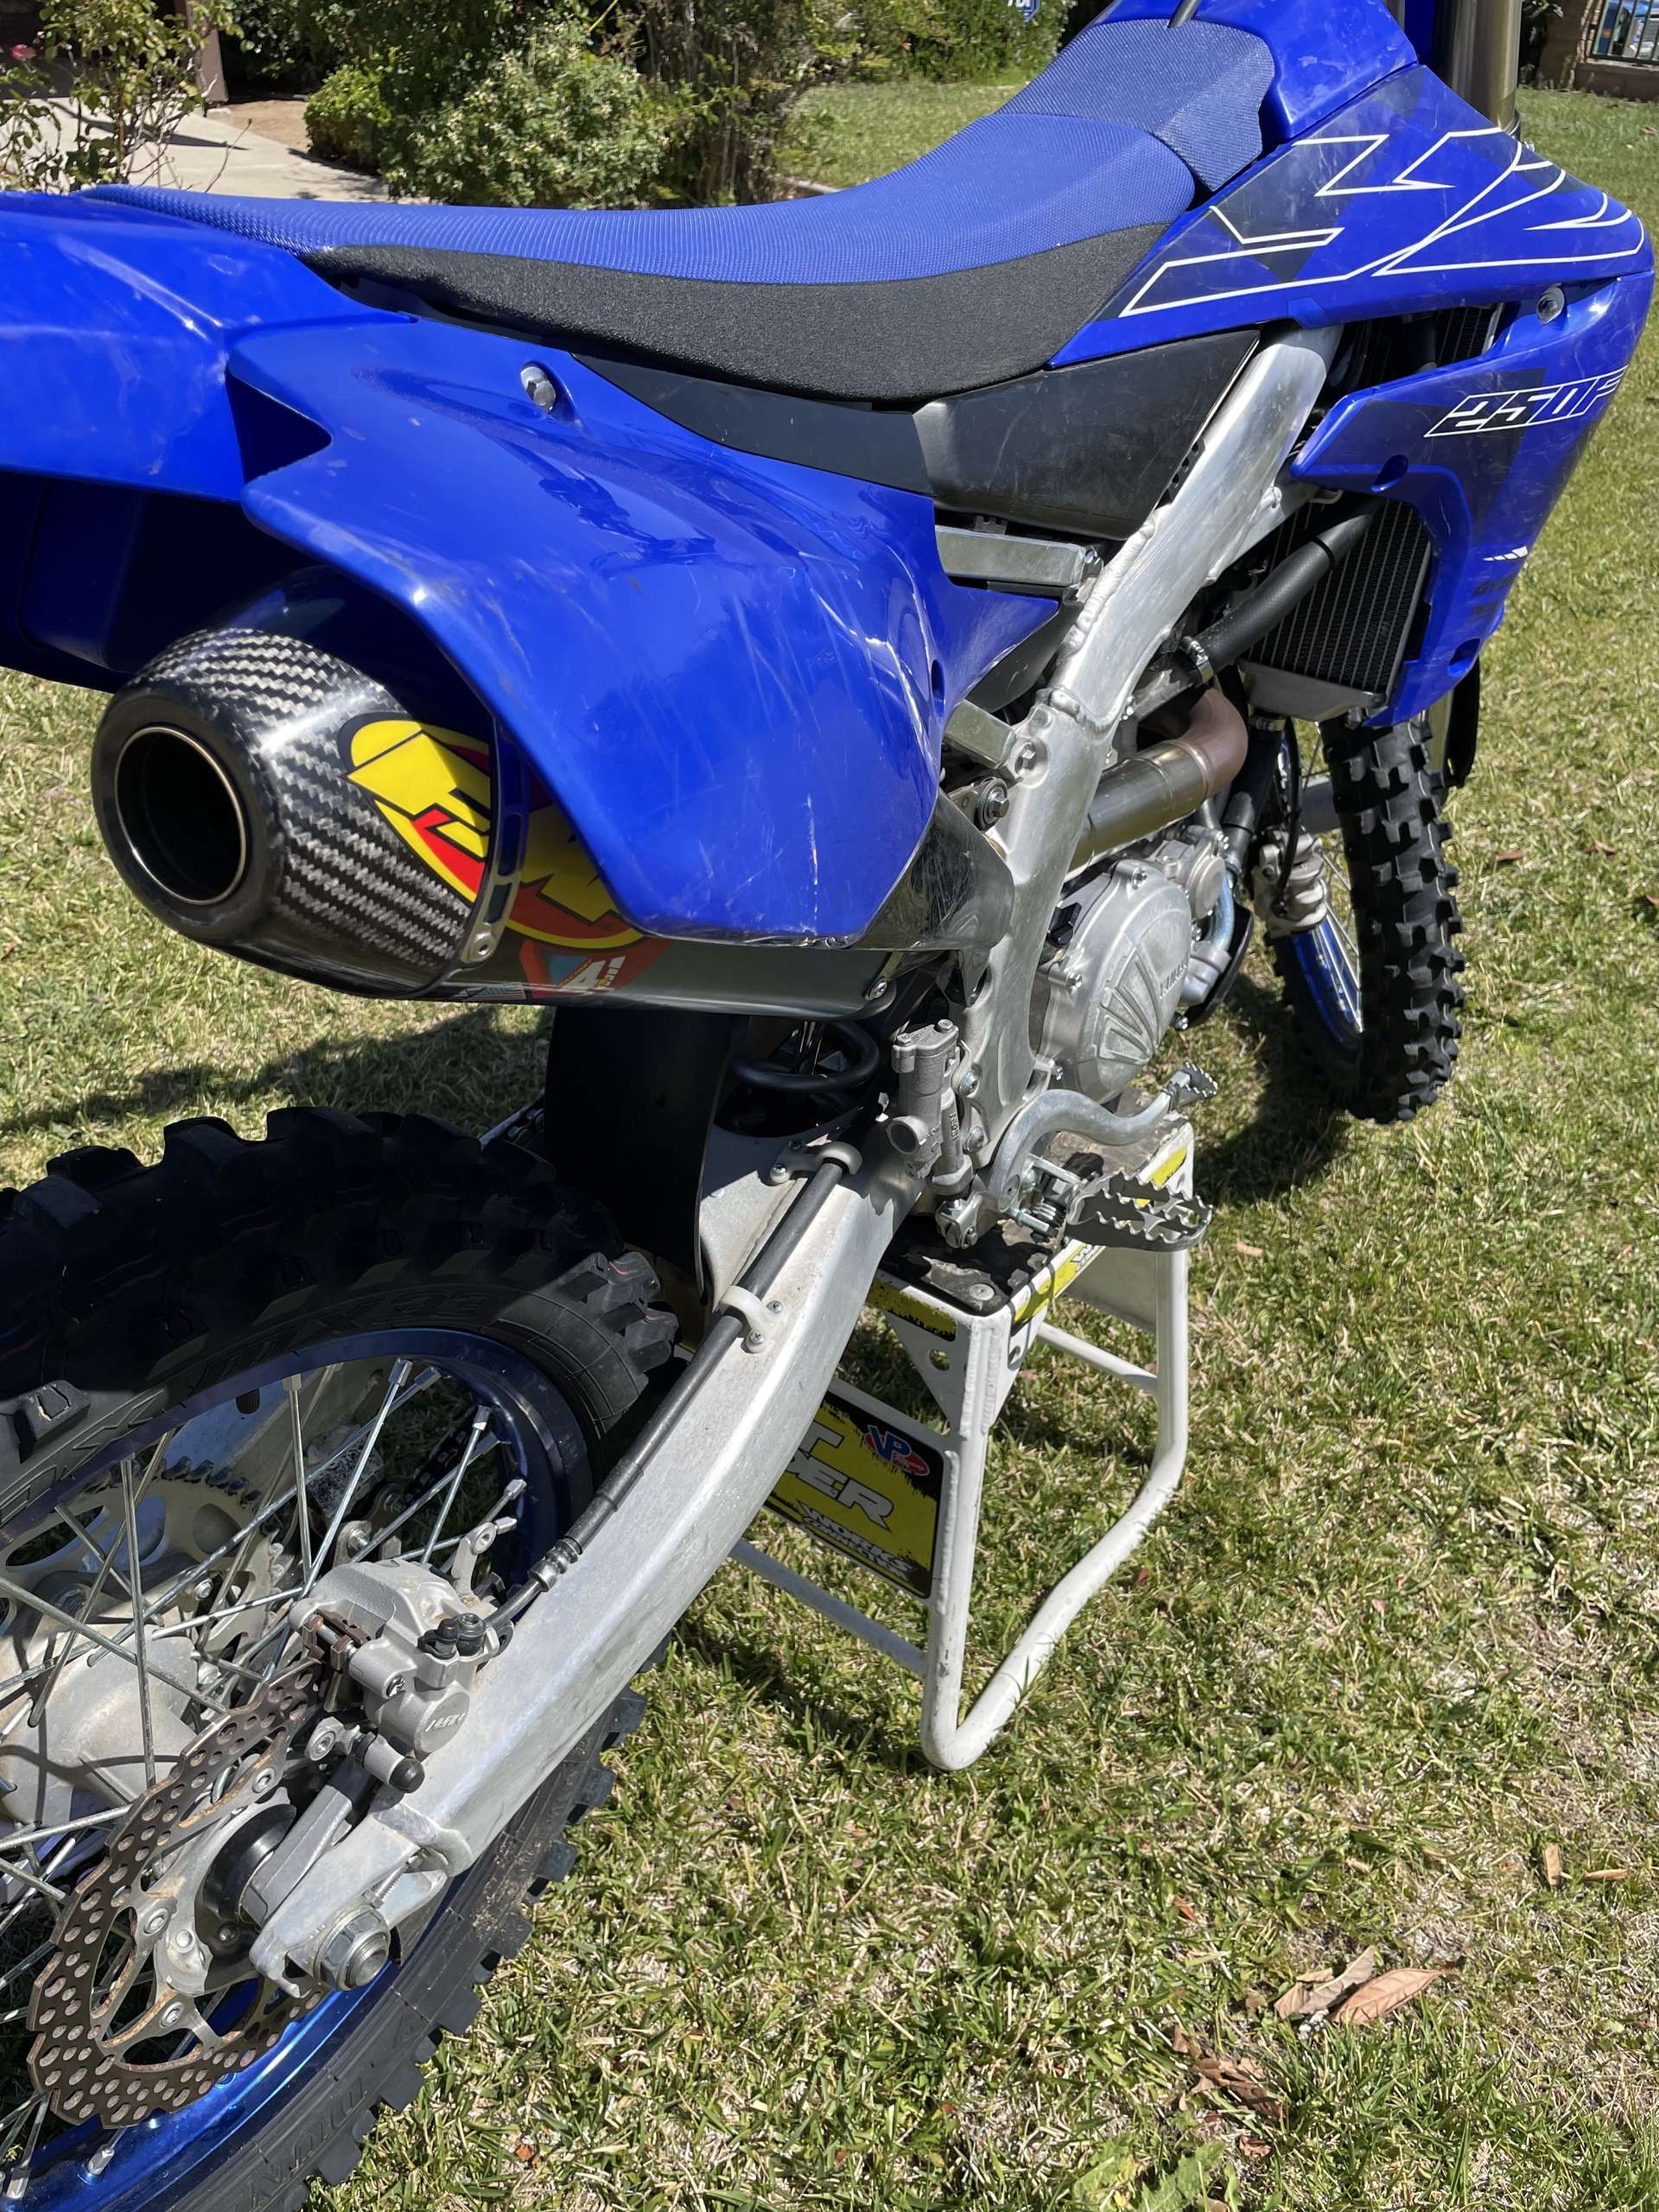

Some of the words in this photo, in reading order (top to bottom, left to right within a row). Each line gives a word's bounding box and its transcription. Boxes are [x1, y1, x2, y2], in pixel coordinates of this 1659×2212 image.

[1424, 365, 1629, 437] 250F
[867, 1424, 912, 1462] VP
[797, 1499, 918, 1572] WORKS
